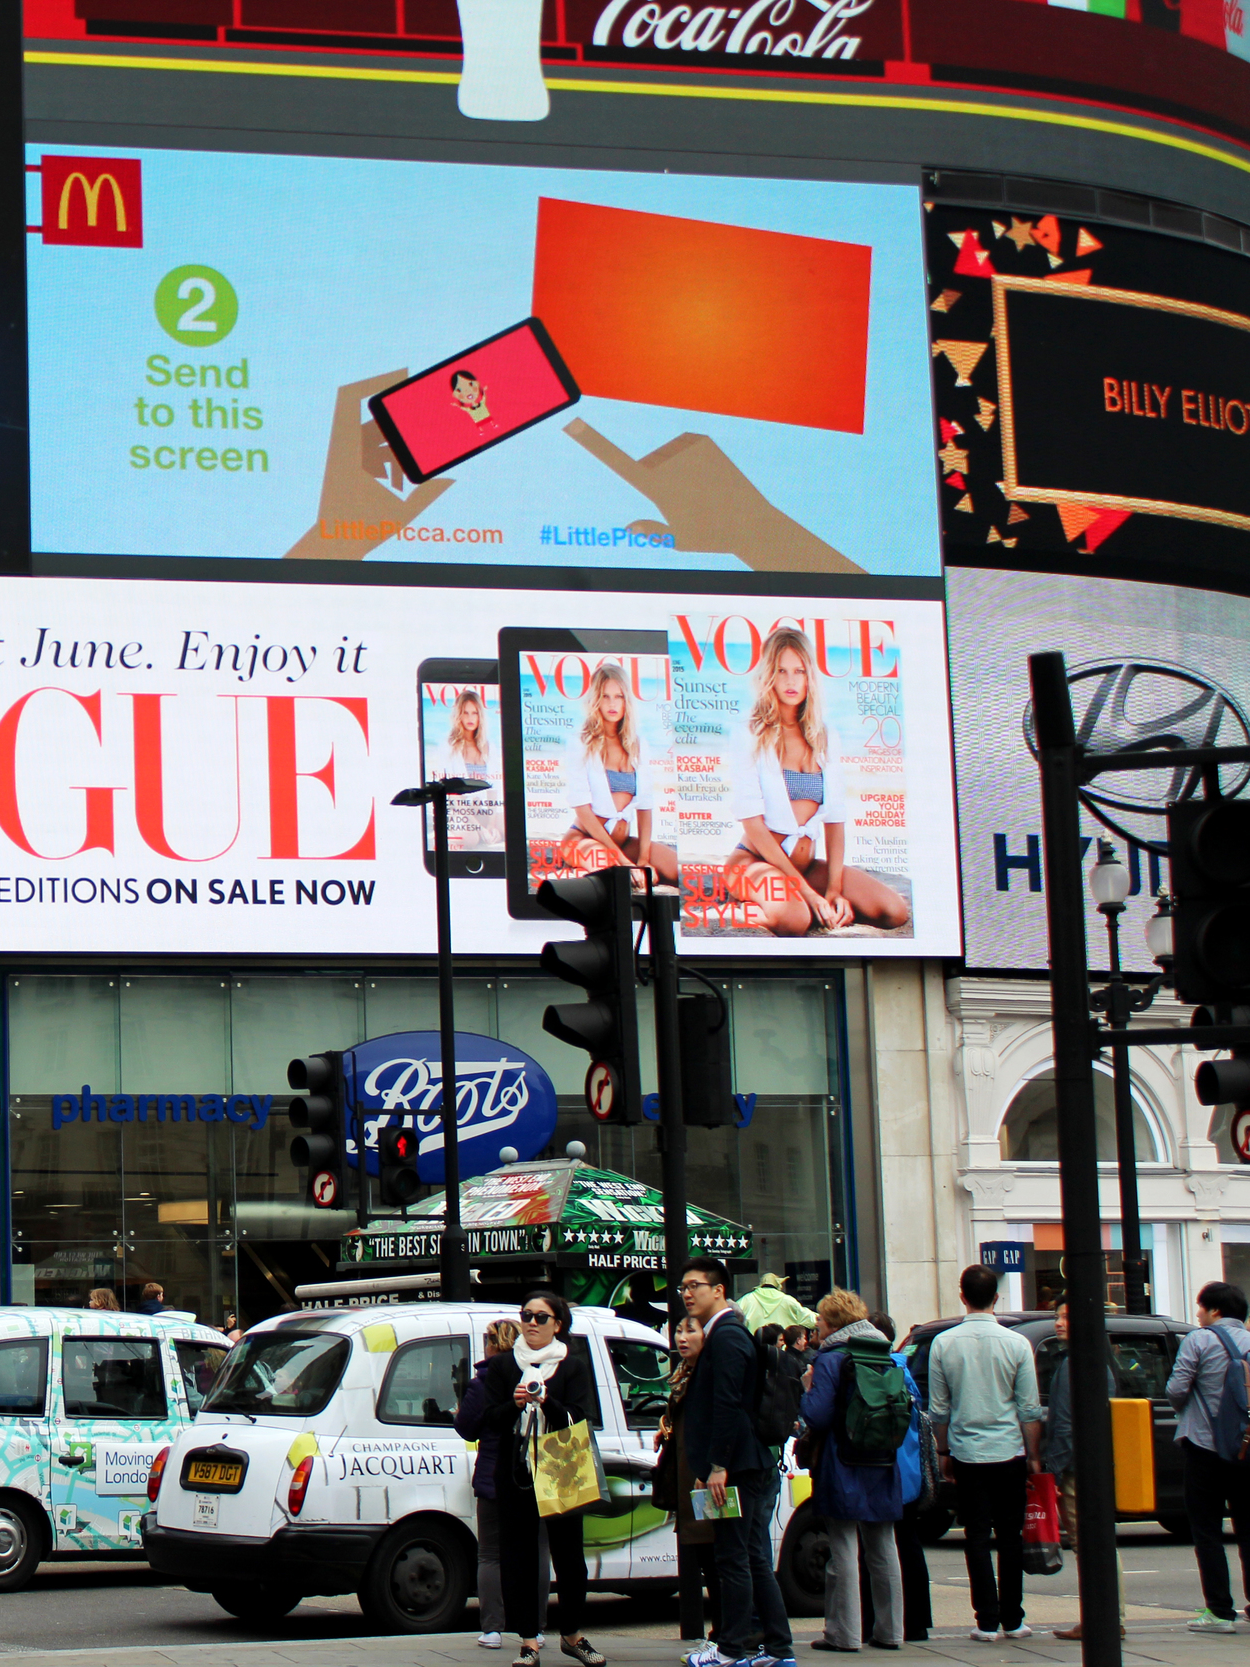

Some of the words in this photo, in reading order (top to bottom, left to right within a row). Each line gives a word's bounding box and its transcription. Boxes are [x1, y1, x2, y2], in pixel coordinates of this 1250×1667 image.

[176, 277, 218, 332] 2
[145, 354, 250, 390] Send
[1103, 376, 1172, 419] BILLY
[134, 397, 175, 428] to
[190, 396, 264, 431] this
[129, 441, 269, 473] screen
[319, 519, 504, 546] LittlePicca.com
[539, 525, 675, 550] #LittlePicca
[19, 627, 153, 670] June.
[175, 631, 318, 682] Enjoy
[334, 635, 368, 674] it
[673, 677, 727, 694] Sunset
[848, 681, 899, 693] MODERN
[674, 695, 740, 715] dressing
[856, 693, 899, 704] BEAUTY
[524, 701, 564, 714] Sunset
[857, 704, 900, 716] SPECIAL
[525, 715, 574, 728] dressing
[675, 711, 697, 723] The
[525, 727, 542, 736] The
[674, 723, 722, 735] evening
[863, 716, 901, 749] 20
[524, 735, 561, 744] evening
[675, 734, 698, 745] edit
[677, 756, 702, 766] ROCK
[705, 756, 722, 766] THE
[677, 764, 715, 773] KASBAH
[677, 774, 698, 783] Kate
[700, 775, 722, 783] Moss
[677, 784, 694, 793] and
[678, 793, 723, 802] Marrakesh
[861, 794, 905, 802] UPGRADE
[878, 802, 905, 811] YOUR
[679, 812, 712, 820] BUTTER
[866, 811, 906, 819] HOLIDAY
[854, 819, 906, 827] WARDROBE
[679, 828, 722, 836] SUPERFOOD
[856, 836, 873, 846] The
[875, 837, 907, 846] Muslim
[873, 847, 908, 855] feminist
[529, 849, 619, 868] SUMMER
[852, 856, 880, 865] taking
[147, 879, 196, 905] ON
[207, 879, 285, 905] SALE
[296, 880, 377, 906] NOW
[682, 875, 803, 902] SUMMER
[683, 903, 760, 929] STYLE
[52, 1084, 272, 1130] pharmacy
[398, 1235, 426, 1257] BEST
[468, 1232, 480, 1253] IN
[589, 1254, 621, 1267] HALF
[624, 1255, 657, 1268] PRICE
[983, 1251, 996, 1265] GAP
[1003, 1249, 1021, 1264] GAP
[352, 1442, 438, 1453] CHAMPAGNE
[105, 1452, 154, 1469] Moving
[339, 1454, 457, 1480] JACQUART
[105, 1470, 149, 1484] Londo
[219, 1465, 240, 1481] DGT
[198, 1505, 214, 1514] 78716
